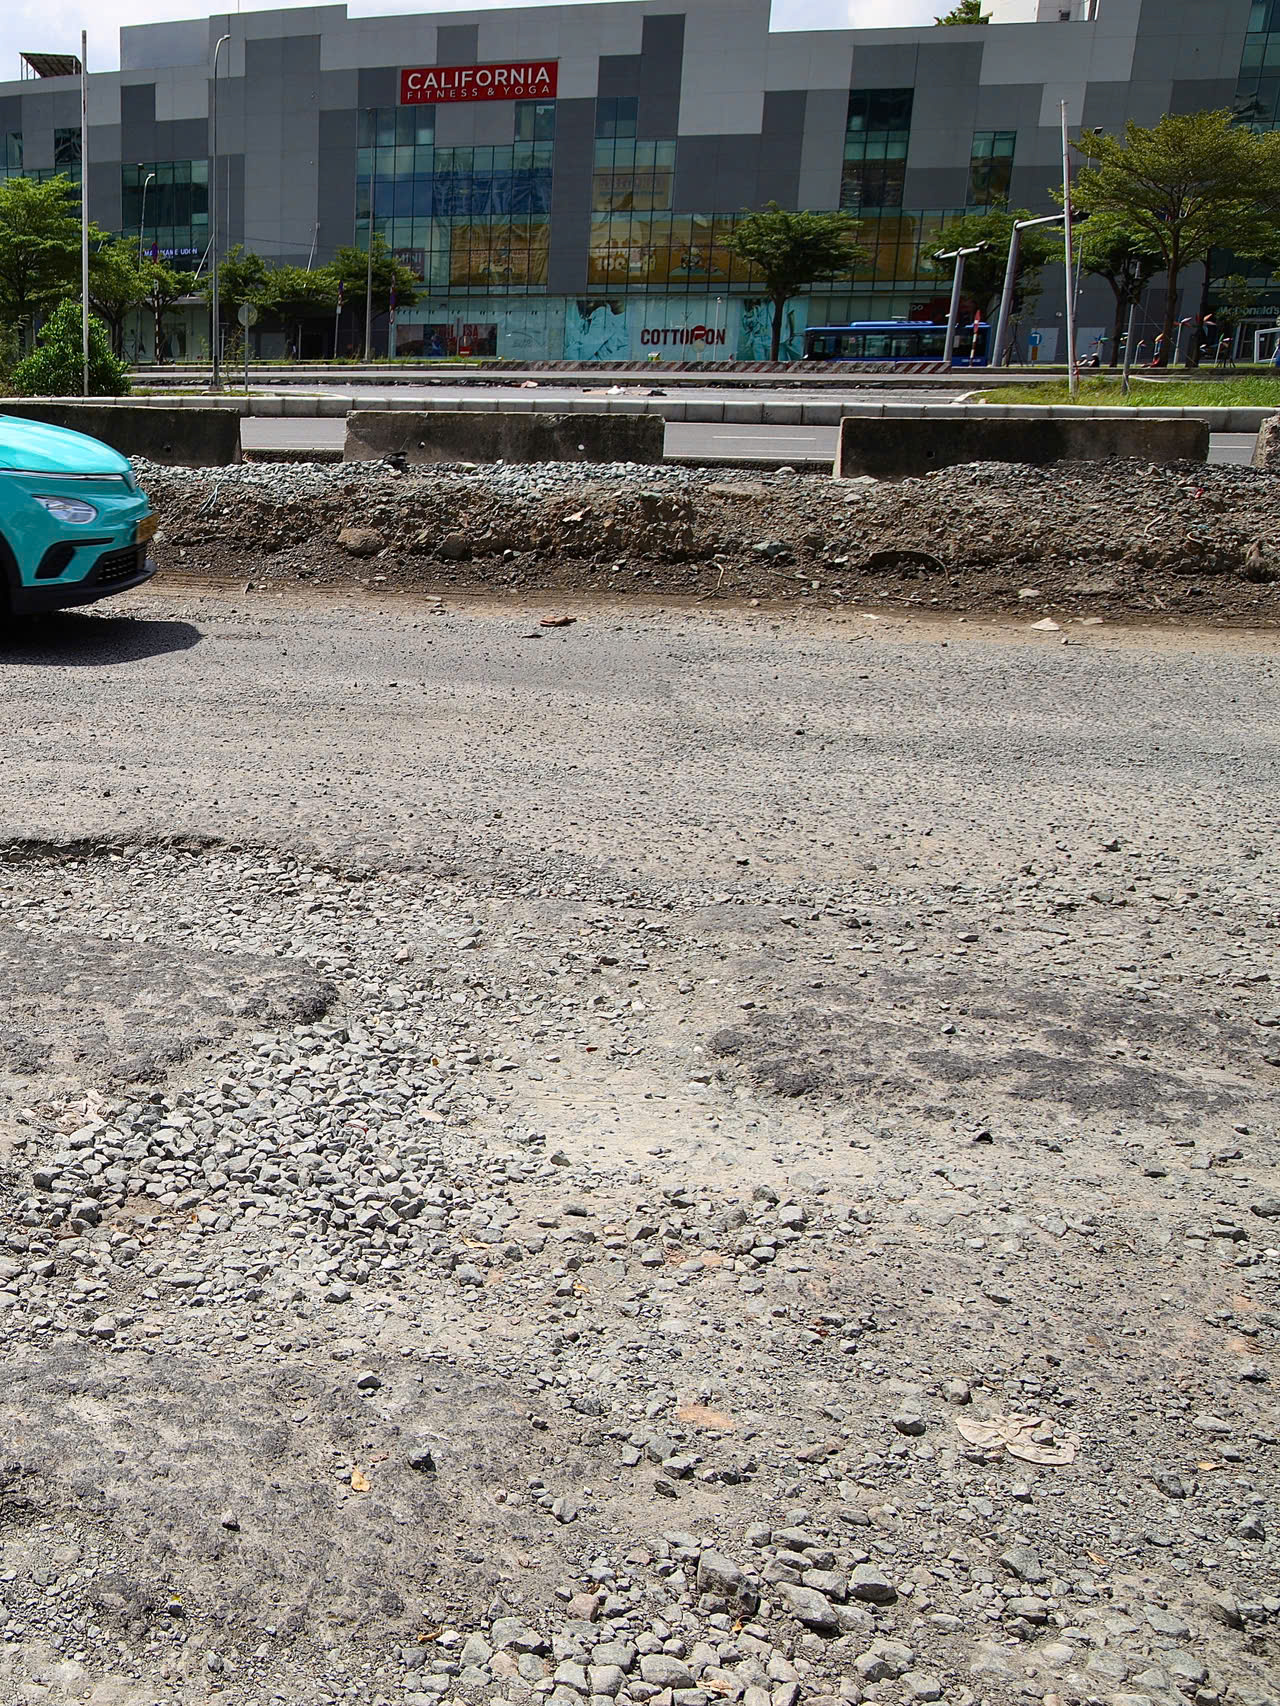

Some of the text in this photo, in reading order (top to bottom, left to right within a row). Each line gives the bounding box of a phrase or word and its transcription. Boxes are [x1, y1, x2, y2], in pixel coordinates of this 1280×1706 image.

[408, 67, 550, 90] CALIFORNIA
[408, 85, 550, 99] FITNESS & YOGA
[705, 328, 726, 345] ON
